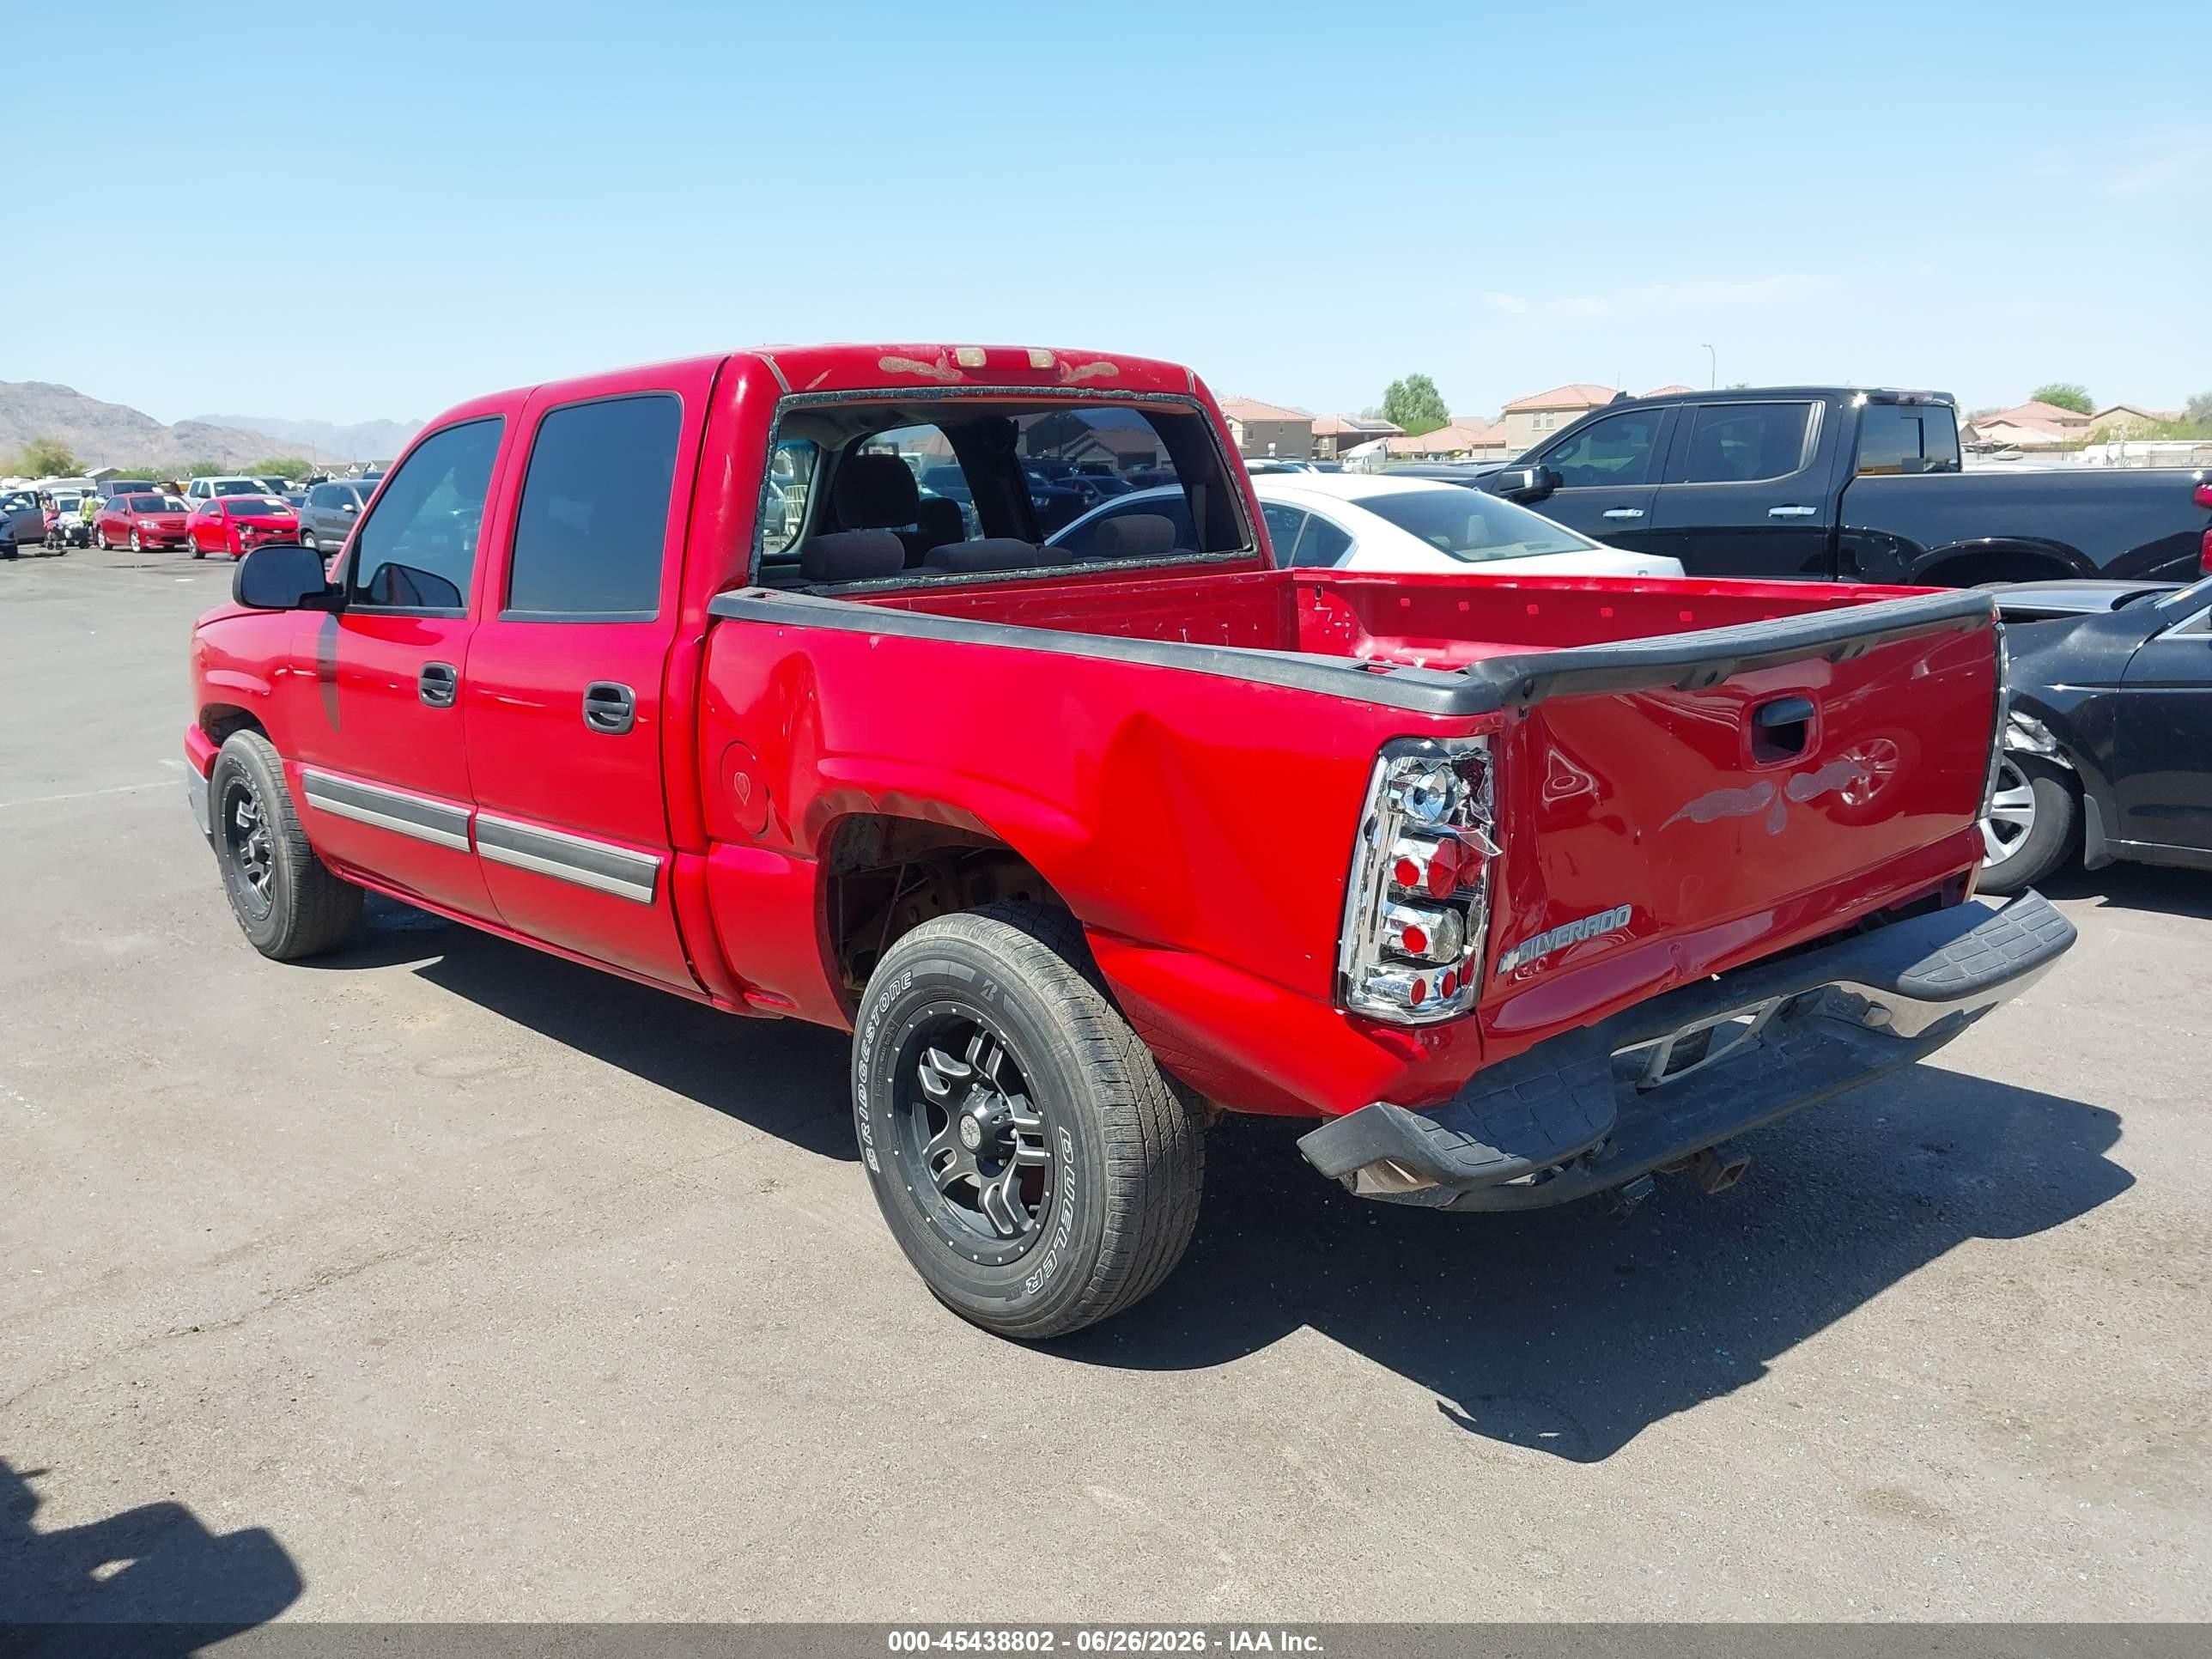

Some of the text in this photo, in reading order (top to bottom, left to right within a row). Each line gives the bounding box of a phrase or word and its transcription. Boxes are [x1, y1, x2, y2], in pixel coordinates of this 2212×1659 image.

[1519, 904, 1632, 963] SILVERADO
[857, 970, 913, 1174] BRIDGESTONE
[1025, 1126, 1076, 1295] DUELER
